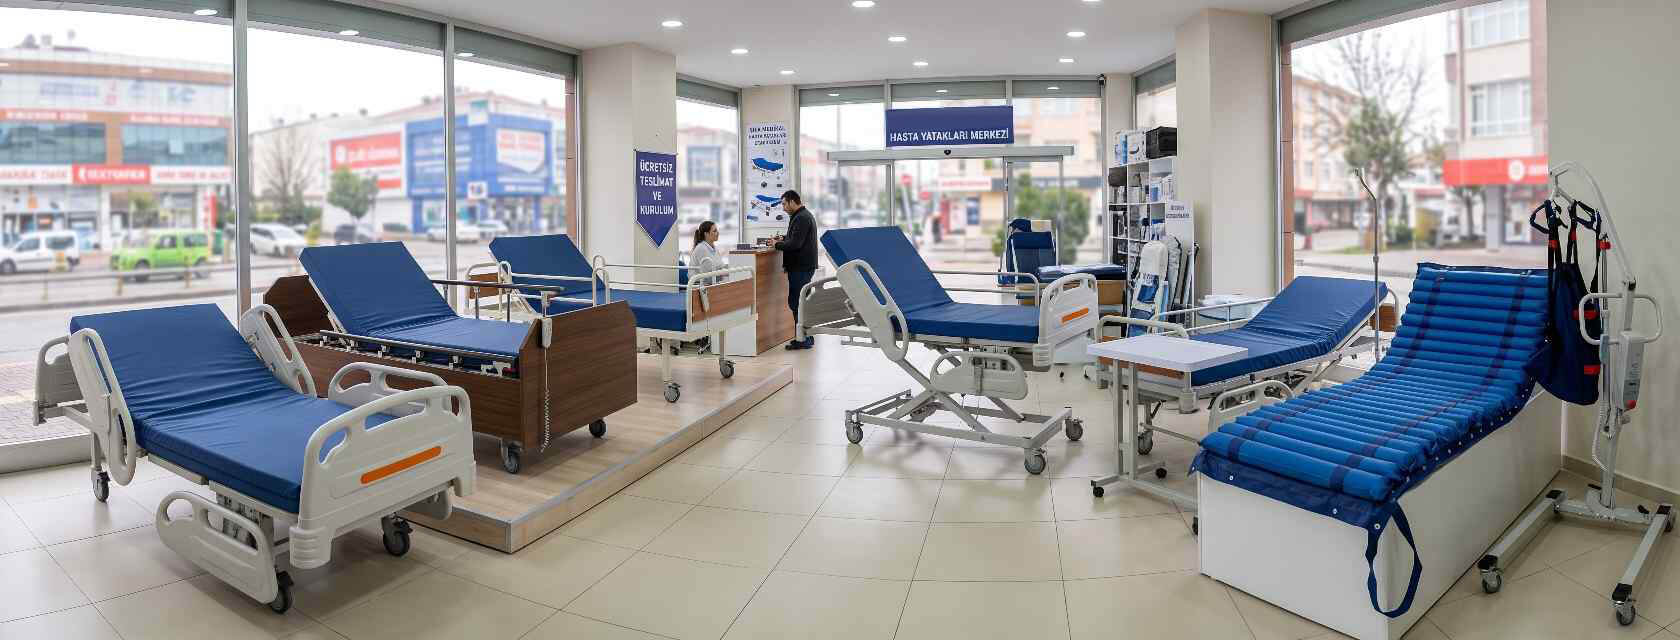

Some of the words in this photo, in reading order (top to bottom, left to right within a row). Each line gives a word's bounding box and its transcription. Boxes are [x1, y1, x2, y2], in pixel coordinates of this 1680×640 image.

[890, 131, 918, 142] HASTA
[970, 128, 1009, 140] MERKEZİ
[640, 159, 673, 173] ÜCRETSİZ
[640, 174, 674, 187] TESLİMAT
[652, 190, 662, 201] VE
[640, 205, 674, 215] KURULUM
